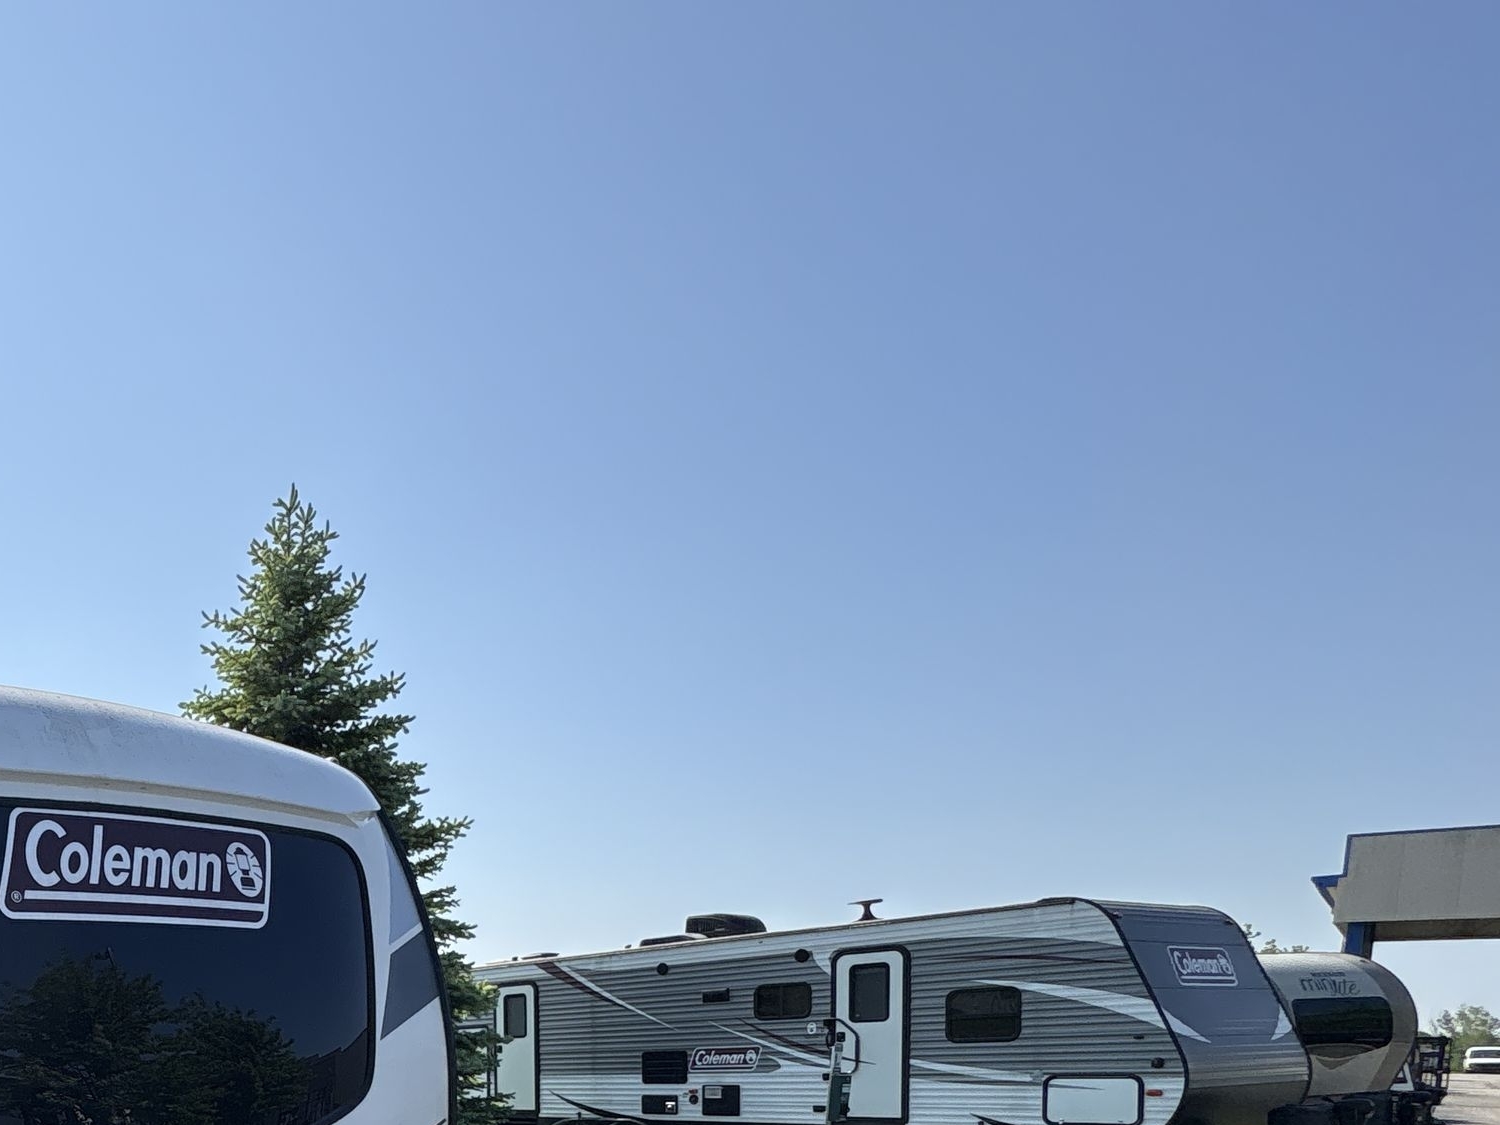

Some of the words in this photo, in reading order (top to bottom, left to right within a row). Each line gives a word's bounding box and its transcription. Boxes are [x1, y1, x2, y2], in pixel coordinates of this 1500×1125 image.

[25, 819, 222, 893] Coleman
[1173, 950, 1223, 975] Coleman
[694, 1050, 745, 1066] Coleman
